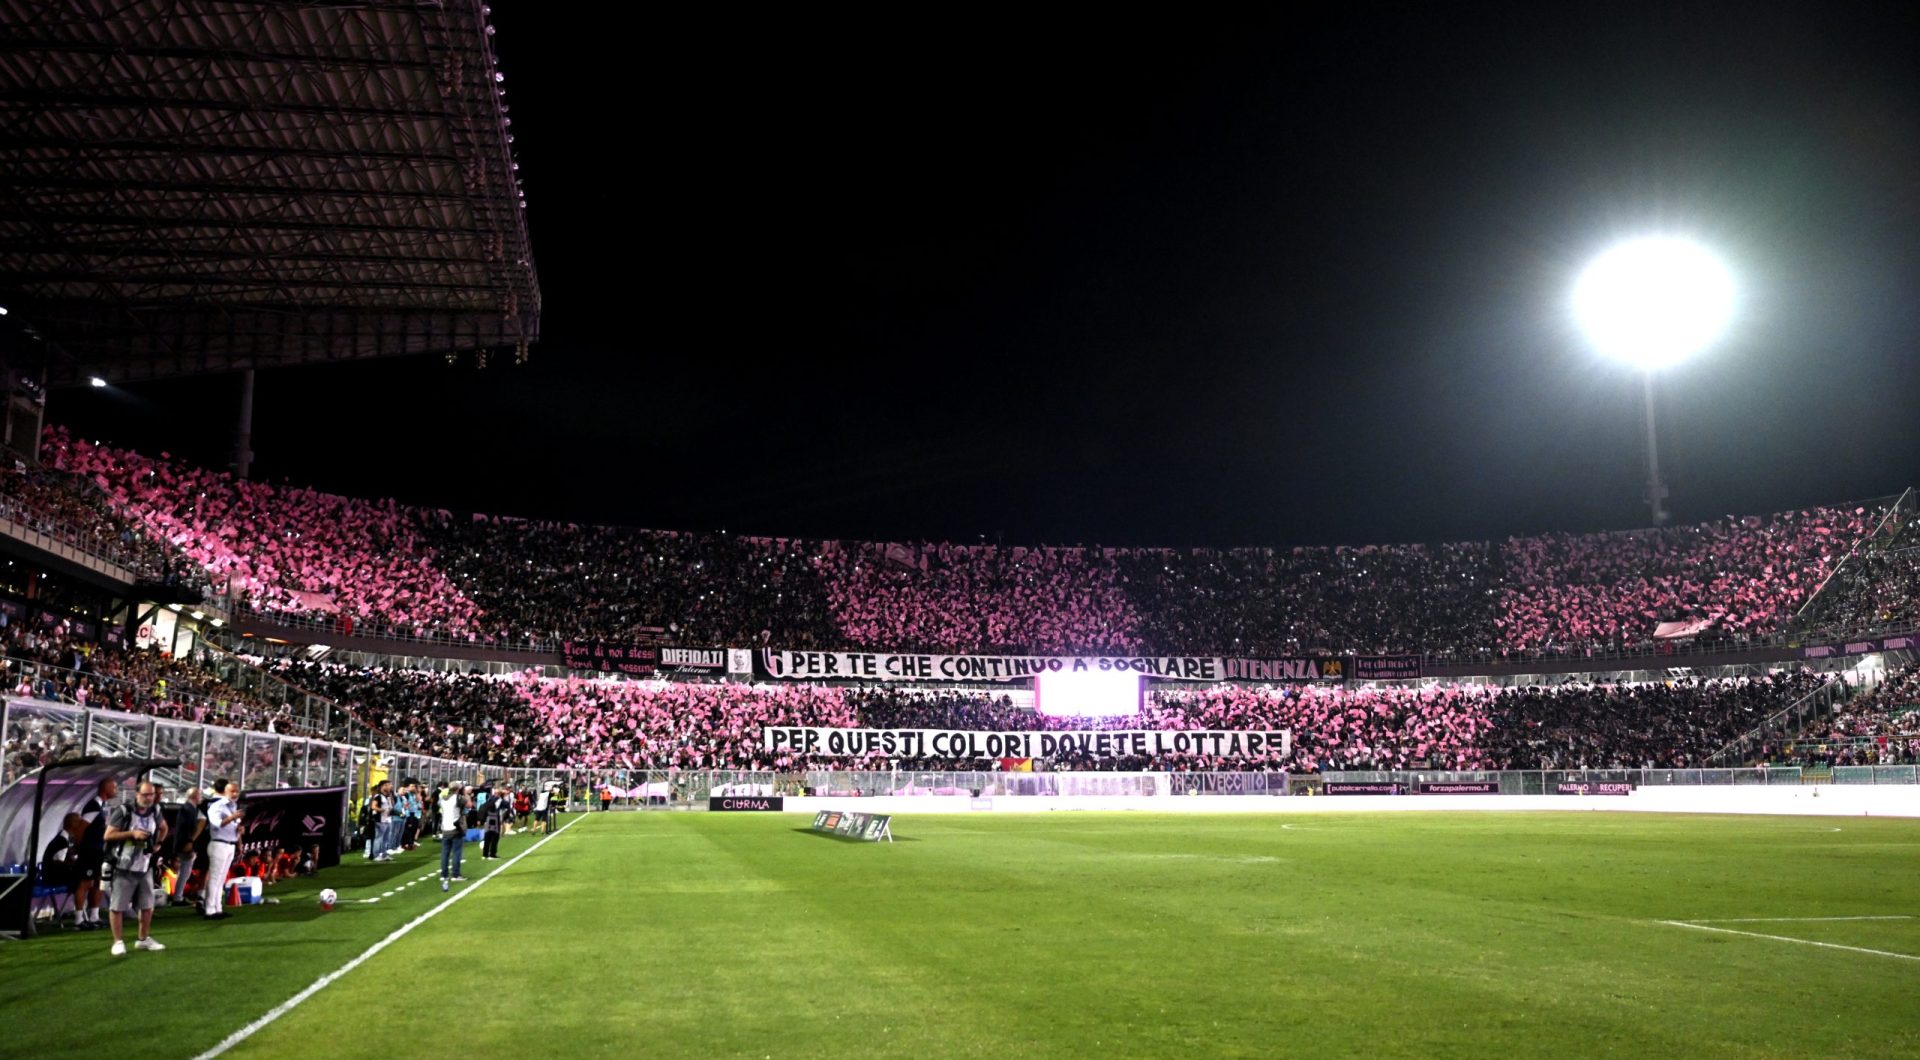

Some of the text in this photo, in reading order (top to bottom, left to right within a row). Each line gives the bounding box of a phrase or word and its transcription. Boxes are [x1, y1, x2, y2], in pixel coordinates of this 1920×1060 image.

[1845, 642, 1868, 654] PUMA
[1884, 637, 1906, 650] PUMA
[594, 644, 604, 657] di
[661, 648, 724, 664] DIFFIDATI
[1805, 646, 1829, 657] PUMA
[791, 652, 1215, 678] PER TE CHE CONTINUO A SOGNARE
[1224, 658, 1319, 680] RTENENZA
[771, 729, 1282, 758] PER QUESTI COLORI DOVETE LOTTARE
[1429, 784, 1489, 793] forzapalermo.it
[1558, 783, 1589, 792] PALERMO
[722, 799, 770, 810] CIURMA
